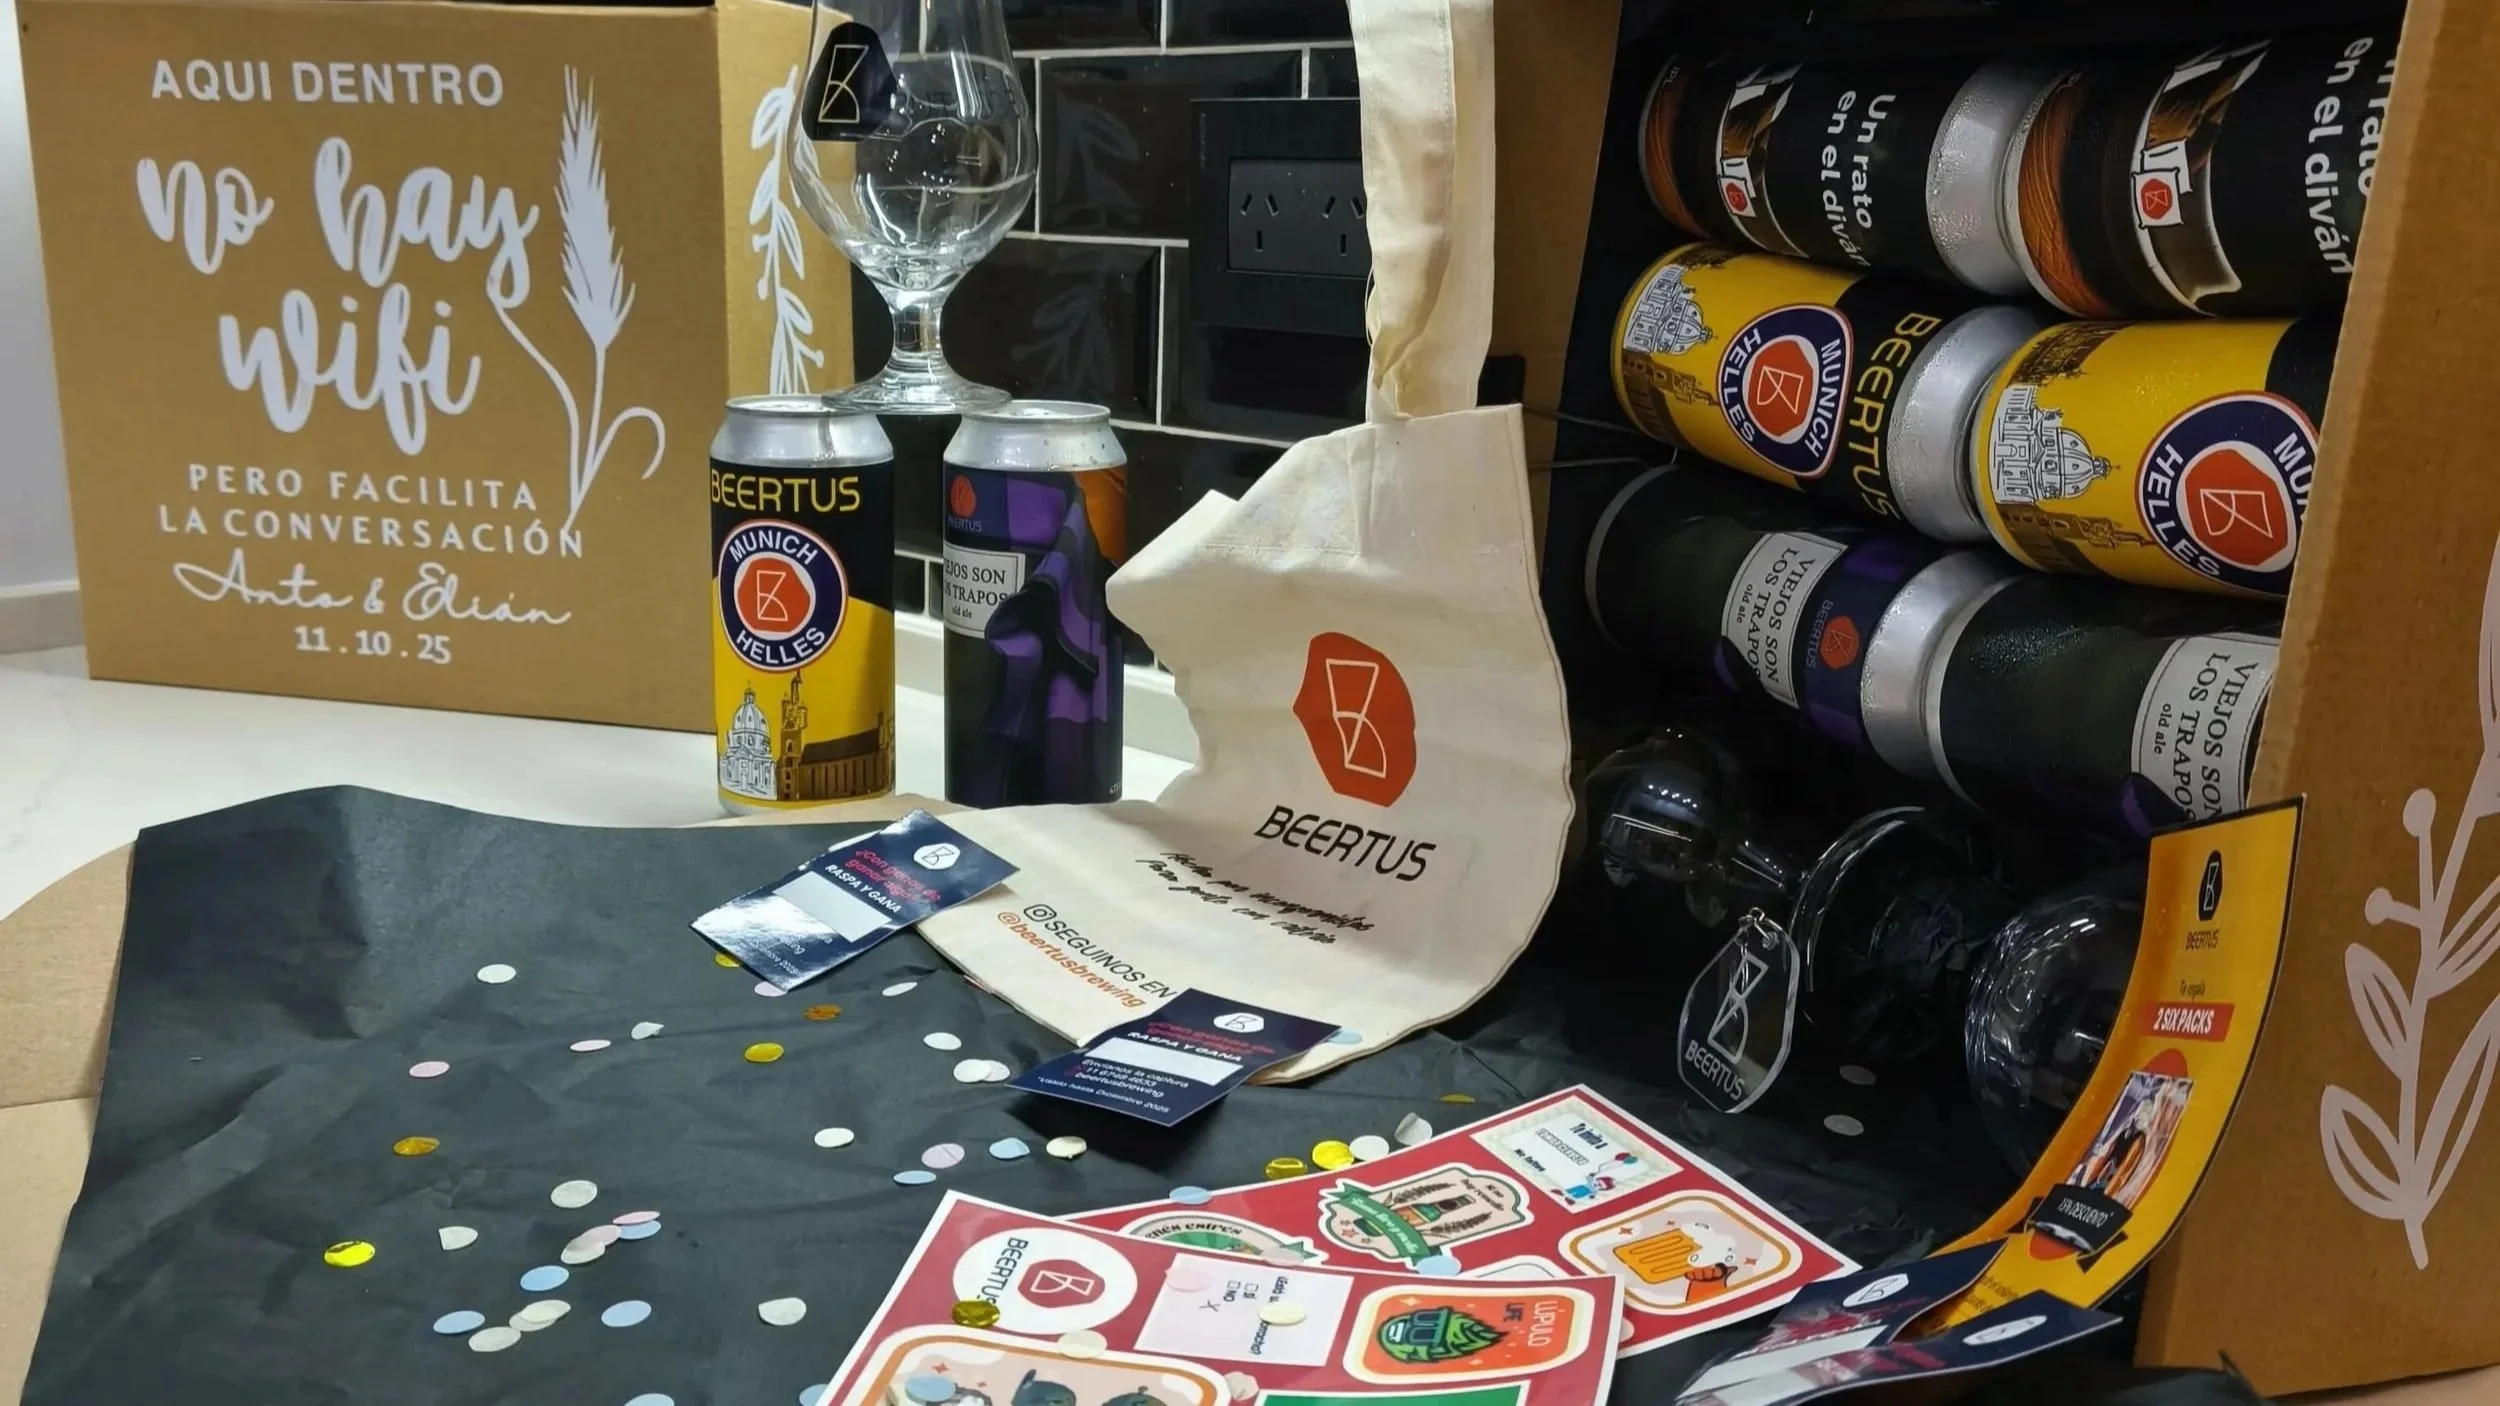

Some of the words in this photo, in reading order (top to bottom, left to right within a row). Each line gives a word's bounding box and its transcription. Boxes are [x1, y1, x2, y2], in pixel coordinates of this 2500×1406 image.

[152, 60, 271, 100] AQUI
[293, 61, 504, 106] DENTRO
[2326, 36, 2374, 84] en
[1827, 90, 1856, 134] en
[1856, 94, 1896, 144] Un
[2308, 95, 2344, 144] el
[1821, 145, 1841, 182] el
[1851, 160, 1873, 229] rato
[2304, 152, 2354, 274] diván
[136, 157, 274, 274] no
[315, 137, 539, 308] hay
[219, 283, 481, 455] wifi
[1720, 327, 1762, 443] HELLES
[1804, 338, 1842, 459] MUNICH
[1848, 312, 1942, 520] BEERTUS
[189, 464, 302, 498] PERO
[329, 473, 536, 511] FACILITA
[711, 468, 861, 512] BEERTUS
[2148, 443, 2221, 577] HELLES
[159, 505, 207, 535] LA
[224, 508, 583, 557] CONVERSACIÓN
[729, 530, 818, 565] MUNICH
[944, 558, 968, 580] EJOS
[972, 567, 1006, 585] SON
[1765, 548, 1800, 585] LOS
[952, 585, 1008, 606] TRAPOS
[1742, 583, 1754, 605] old
[1769, 558, 1816, 631] VIEJOS
[736, 626, 826, 665] HELLES
[1747, 592, 1771, 681] TRAPOS
[1806, 600, 1834, 669] BEERTUS
[1765, 639, 1780, 683] SON
[2189, 652, 2232, 702] LOS
[2157, 703, 2173, 729] old
[2203, 662, 2259, 759] VIEJOS
[2154, 732, 2168, 755] ale
[1254, 805, 1437, 882] BEERTUS
[825, 864, 862, 888] RASPA
[860, 884, 873, 893] Y
[868, 891, 903, 913] GANA
[997, 911, 1148, 1008] @beertusbrewing
[1044, 920, 1146, 983] SEGUINOS
[1139, 980, 1178, 999] EN
[2186, 929, 2219, 951] BEERTUS
[2153, 1008, 2164, 1031] 2
[2161, 1008, 2181, 1032] SIX
[2177, 1008, 2215, 1035] PACKS
[1685, 1039, 1745, 1100] BEERTUS
